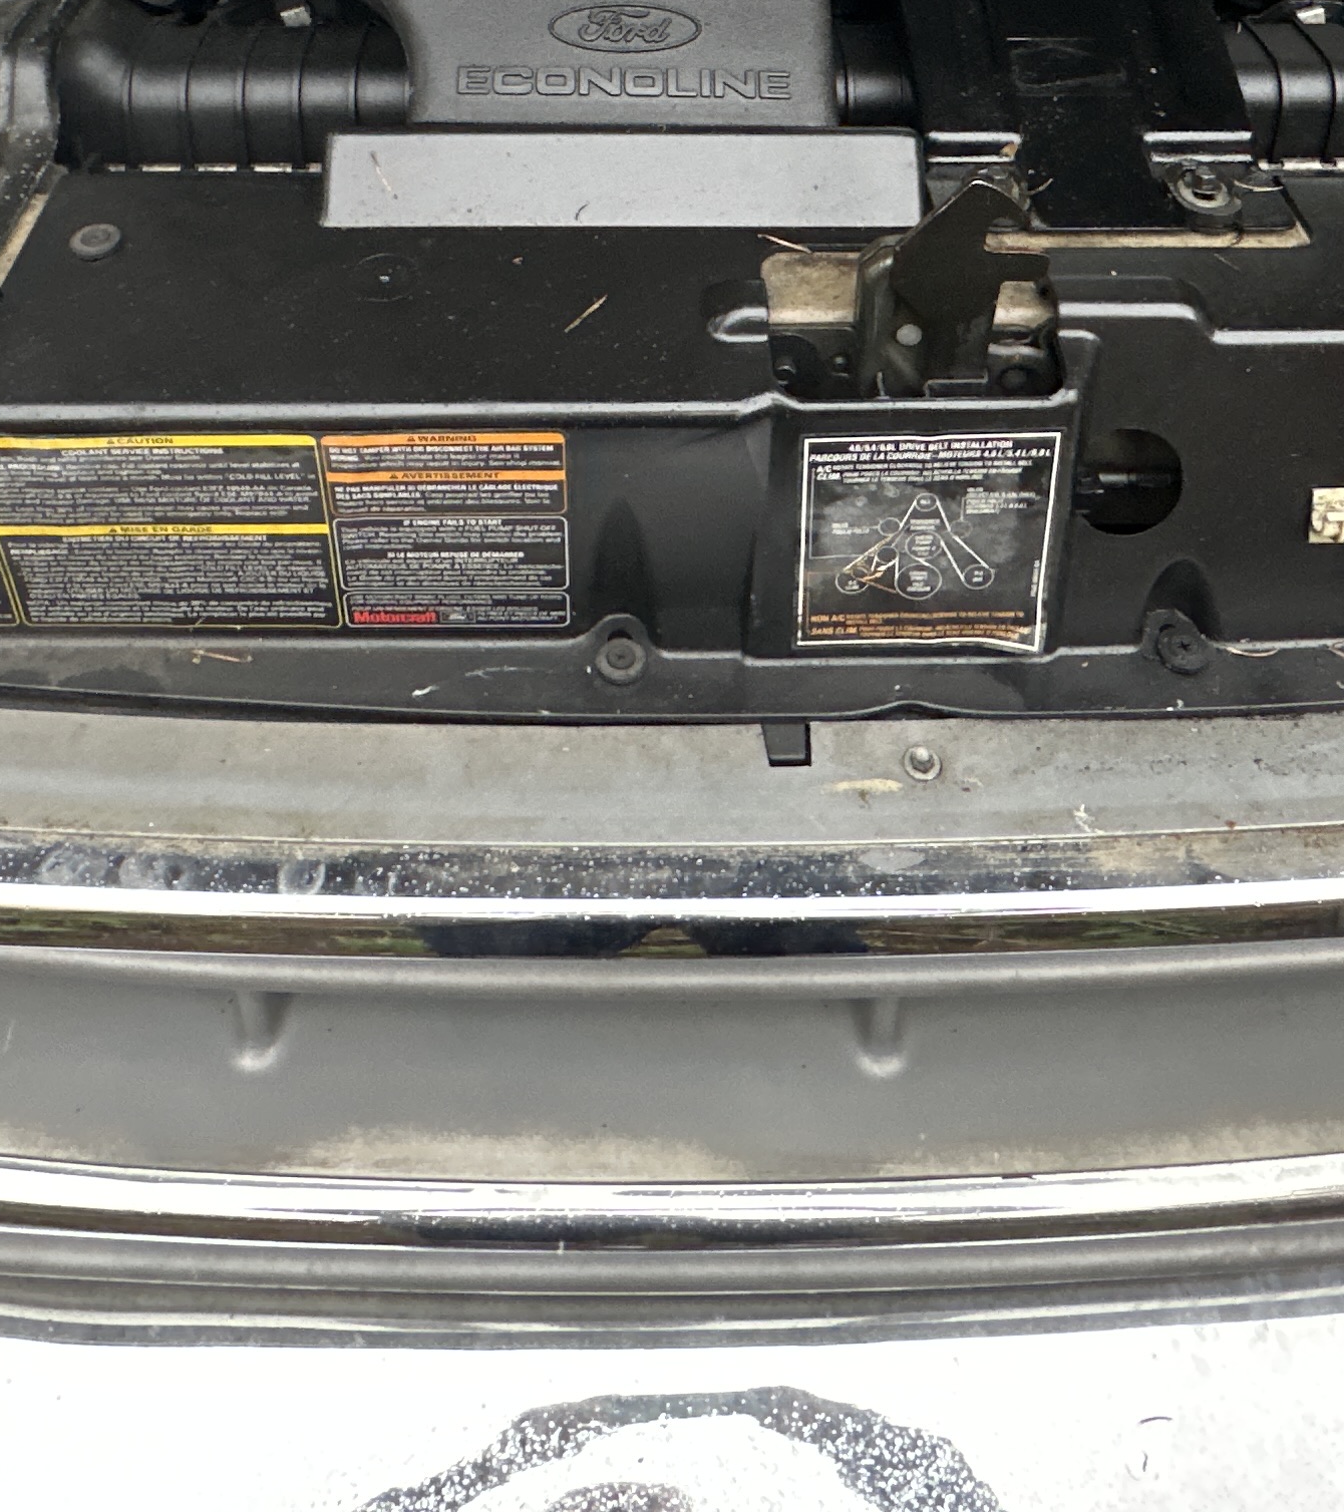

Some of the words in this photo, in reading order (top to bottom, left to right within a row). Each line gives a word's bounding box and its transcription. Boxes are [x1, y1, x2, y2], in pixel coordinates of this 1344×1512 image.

[577, 5, 672, 44] Ford
[456, 65, 793, 100] ECONOLINE
[899, 443, 926, 451] DRIVE
[928, 442, 948, 450] BELT
[950, 441, 1013, 449] INSTALLATION
[62, 448, 108, 456] COOLANT
[809, 453, 857, 462] PARCOURS
[859, 452, 872, 460] DE
[873, 452, 885, 460] LA
[353, 610, 437, 623] Motorcraft
